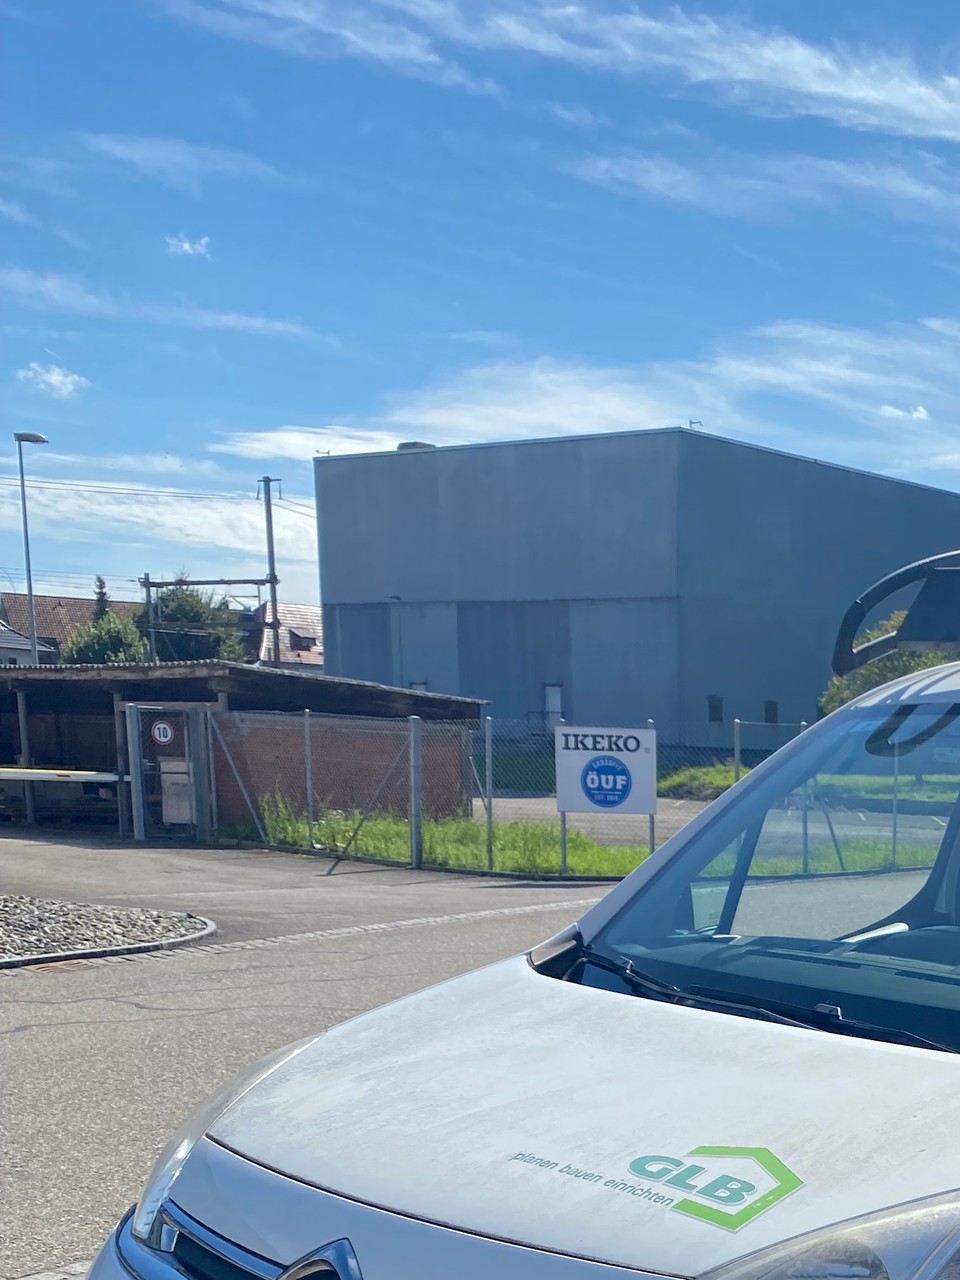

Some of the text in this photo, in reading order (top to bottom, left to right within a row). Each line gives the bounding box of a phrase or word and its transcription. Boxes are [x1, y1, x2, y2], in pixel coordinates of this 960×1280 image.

[156, 727, 168, 739] 10
[562, 733, 641, 753] IKEKO
[586, 771, 627, 790] ÖUF
[509, 1151, 675, 1207] planen bauen einrichten
[629, 1154, 757, 1205] GLB
